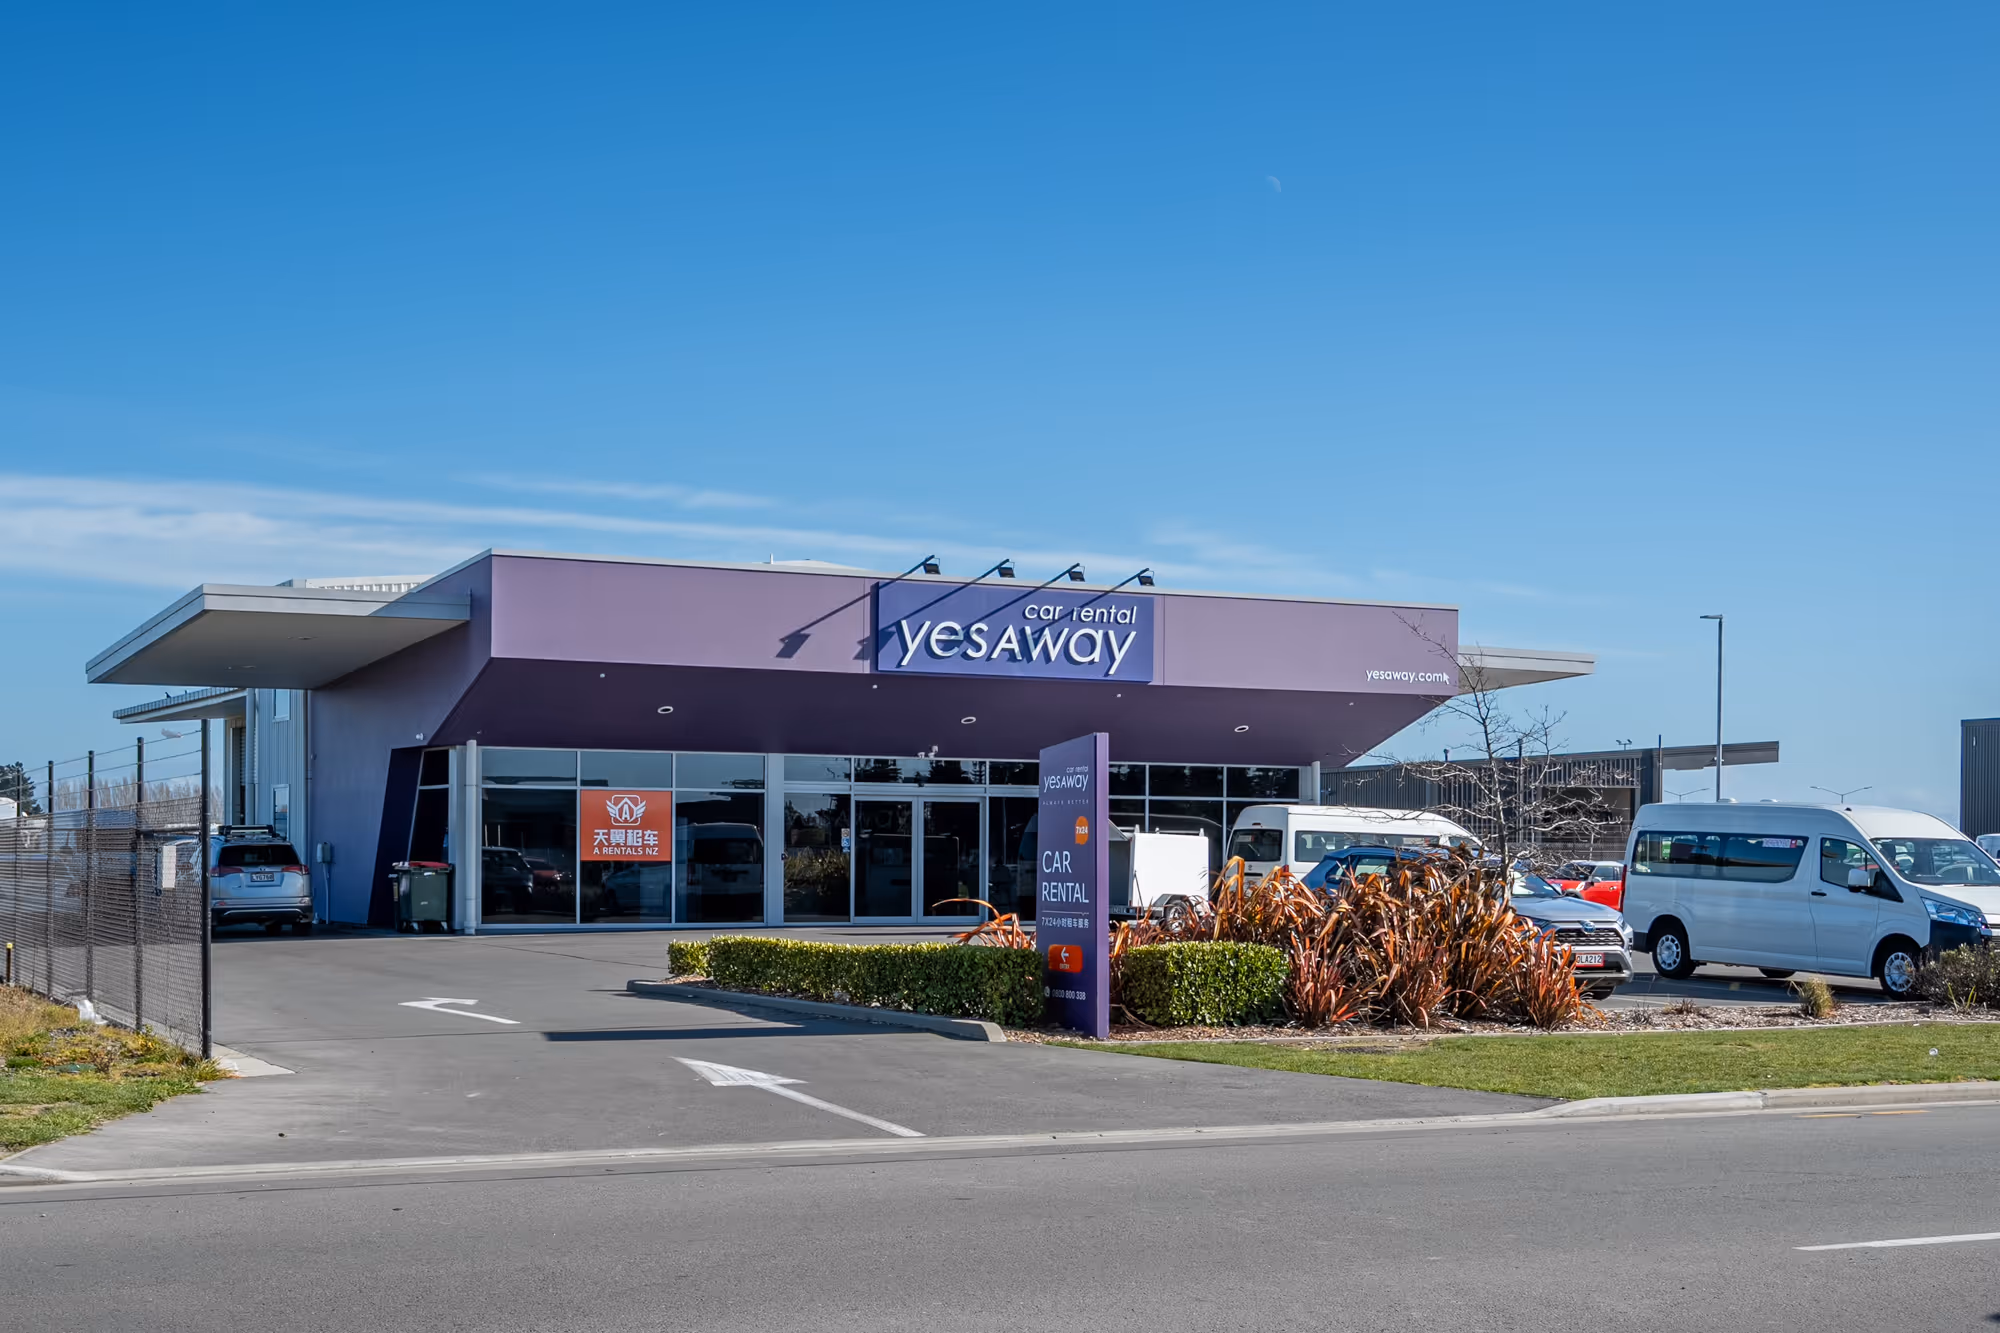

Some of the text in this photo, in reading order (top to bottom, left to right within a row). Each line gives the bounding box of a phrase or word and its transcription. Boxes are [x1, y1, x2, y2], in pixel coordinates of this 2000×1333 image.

[1024, 604, 1137, 624] car rental
[1366, 670, 1443, 683] yesaway.com
[602, 847, 643, 855] RENTALS
[1042, 851, 1072, 873] CAR
[1042, 881, 1090, 903] RENTAL
[1052, 989, 1086, 1000] 0800 800 338
